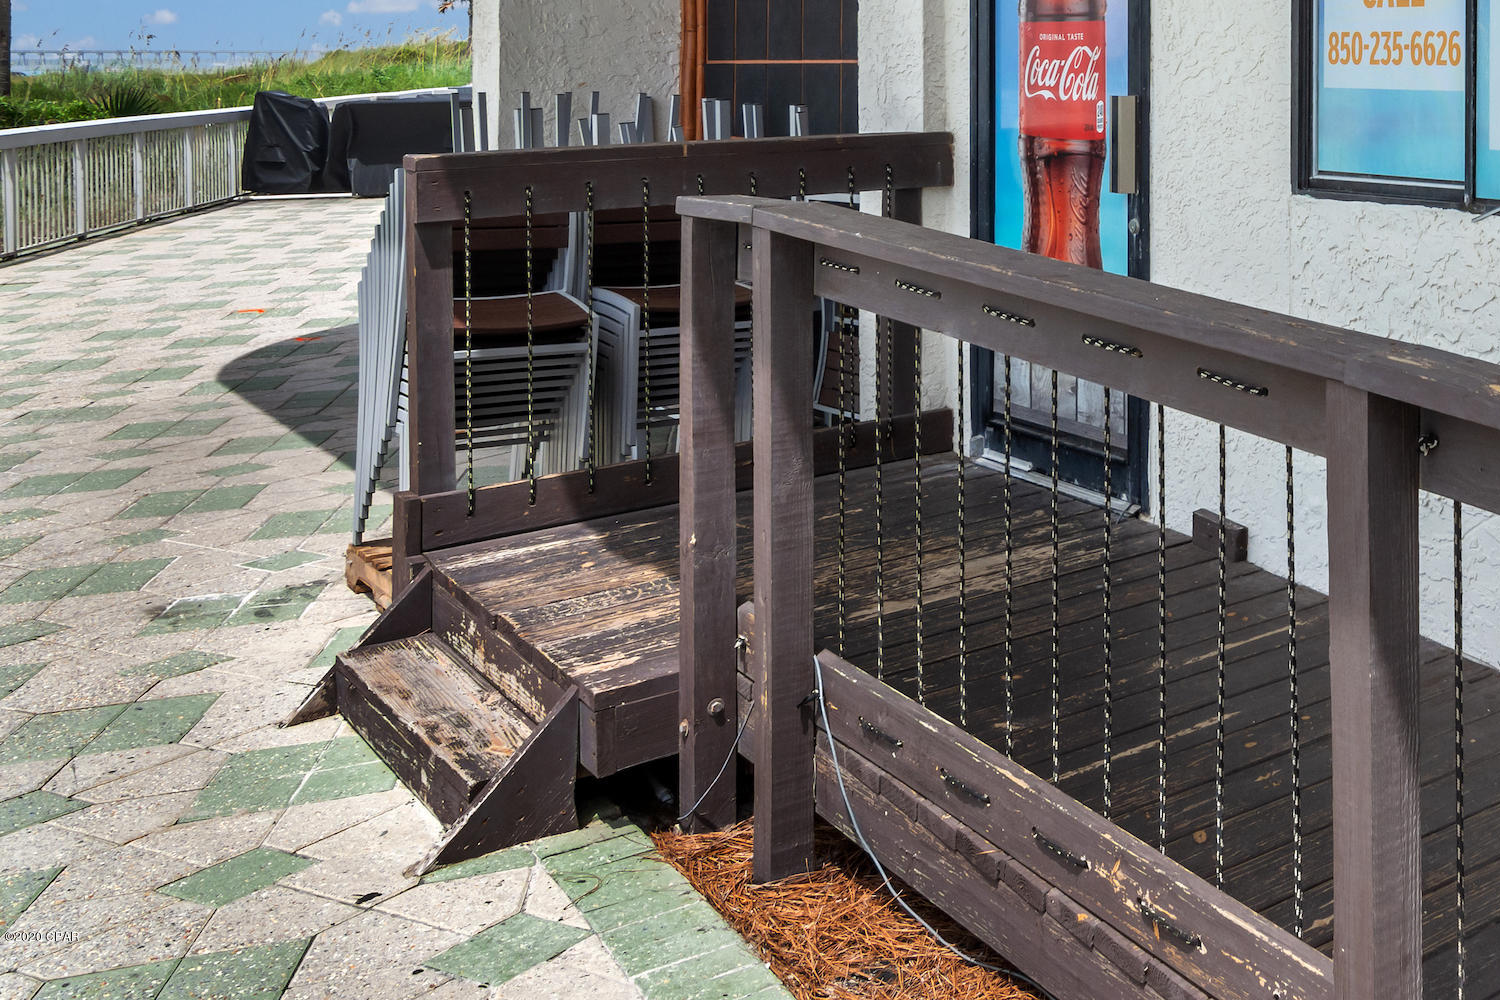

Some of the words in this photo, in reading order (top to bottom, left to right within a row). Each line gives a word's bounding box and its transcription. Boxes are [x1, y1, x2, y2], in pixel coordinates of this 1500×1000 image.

[1039, 33, 1066, 41] ORIGINAL
[1067, 32, 1084, 41] TASTE
[1328, 31, 1461, 66] 850-235-6626
[1024, 45, 1102, 102] Coca-Cola
